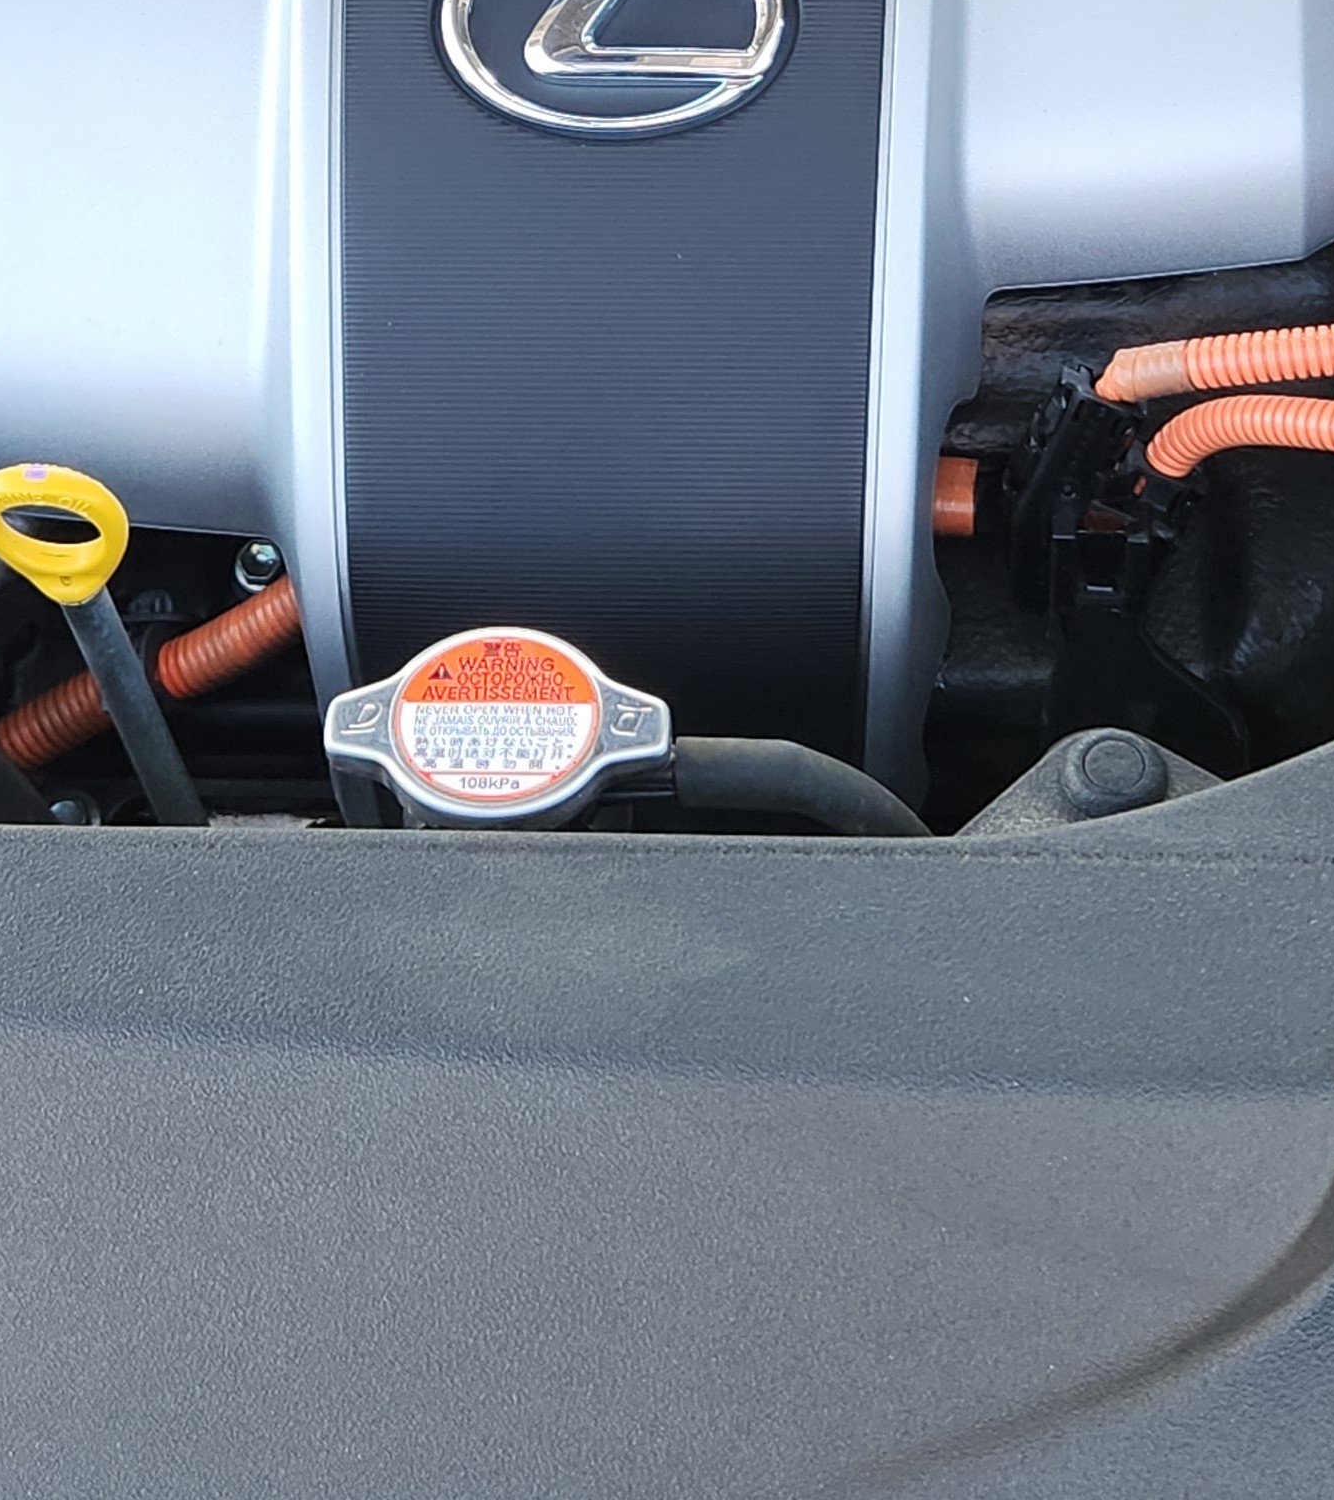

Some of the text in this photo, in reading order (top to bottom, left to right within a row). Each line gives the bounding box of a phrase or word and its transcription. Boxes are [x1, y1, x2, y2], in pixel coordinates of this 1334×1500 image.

[458, 657, 556, 672] WARNING
[456, 671, 565, 687] ОСТОРОЖНО
[421, 686, 576, 701] AVERTISSEMENT
[415, 705, 459, 715] NEVER
[463, 705, 500, 715] OPEN
[503, 705, 542, 716] WHEN
[433, 715, 475, 725] JAMAIS
[459, 776, 521, 790] 108kPa
